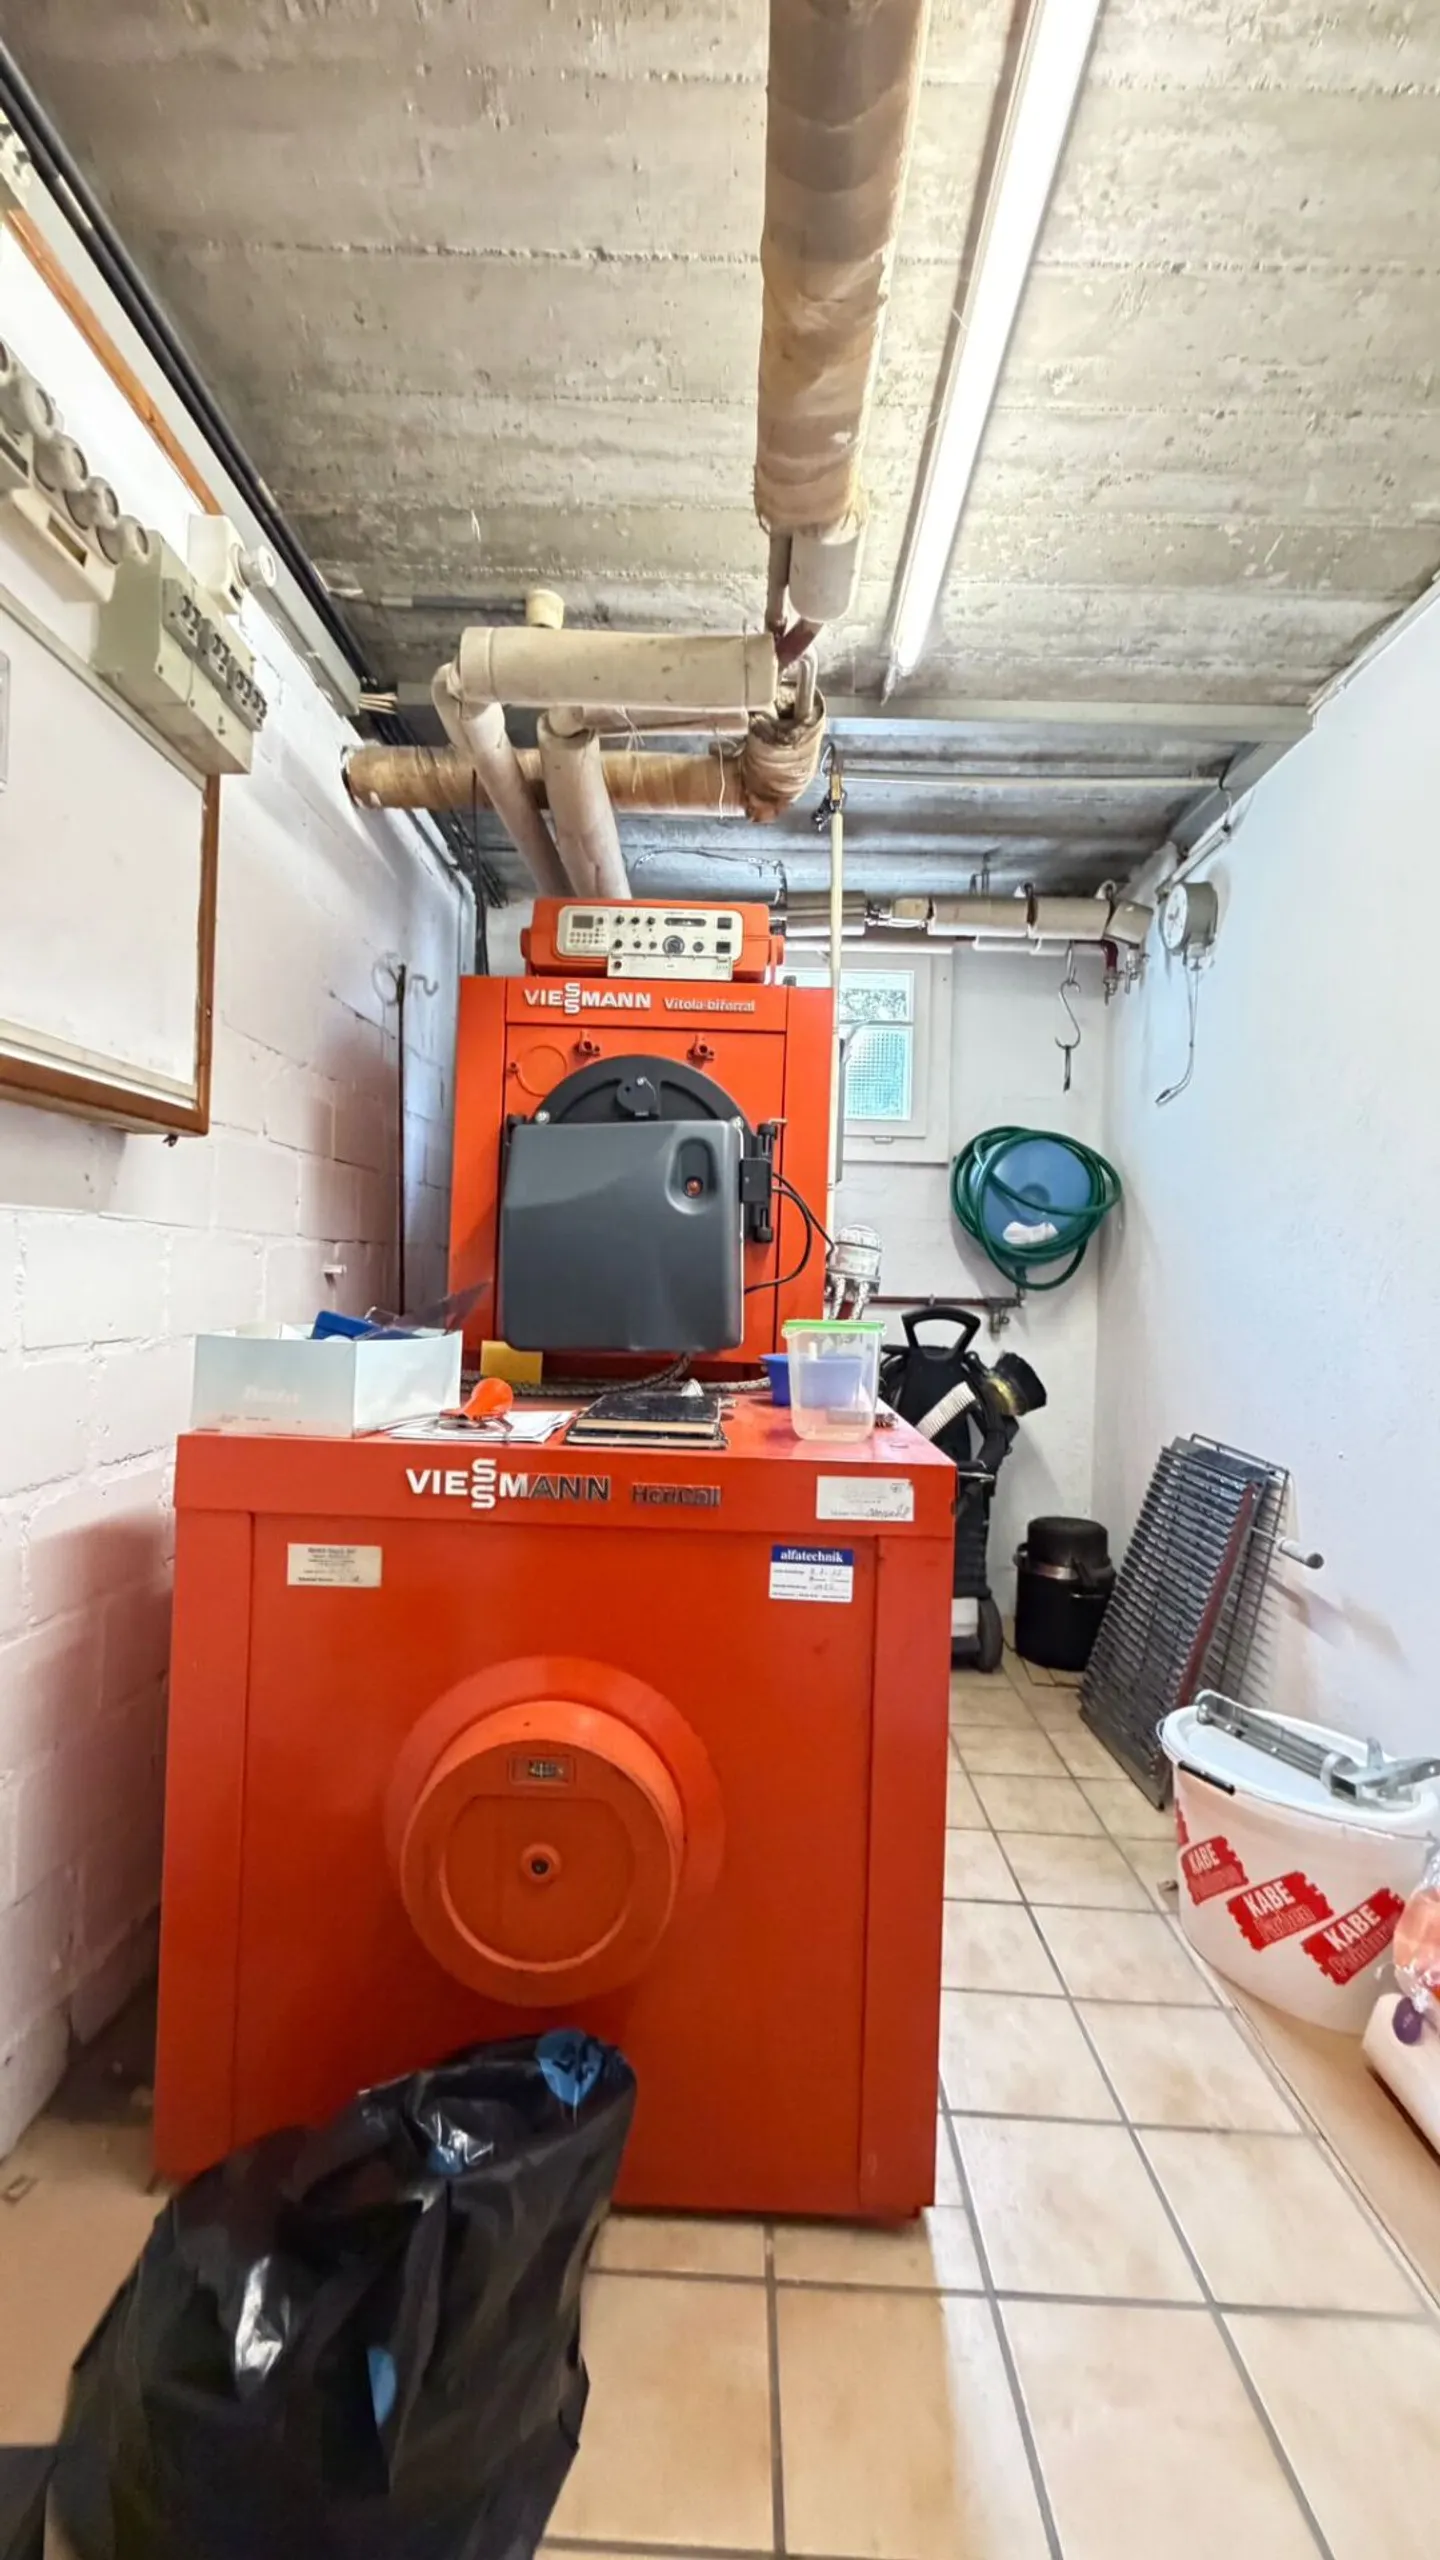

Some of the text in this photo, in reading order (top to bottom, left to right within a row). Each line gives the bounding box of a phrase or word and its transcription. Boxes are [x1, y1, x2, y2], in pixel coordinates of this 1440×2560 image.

[524, 982, 651, 1015] VIESSMANN
[405, 1458, 612, 1510] VIESSMANN
[780, 1548, 844, 1563] alfatechnik
[1188, 1842, 1220, 1876] KABE
[1242, 1880, 1296, 1918] KABE
[1323, 1904, 1381, 1952] KABE
